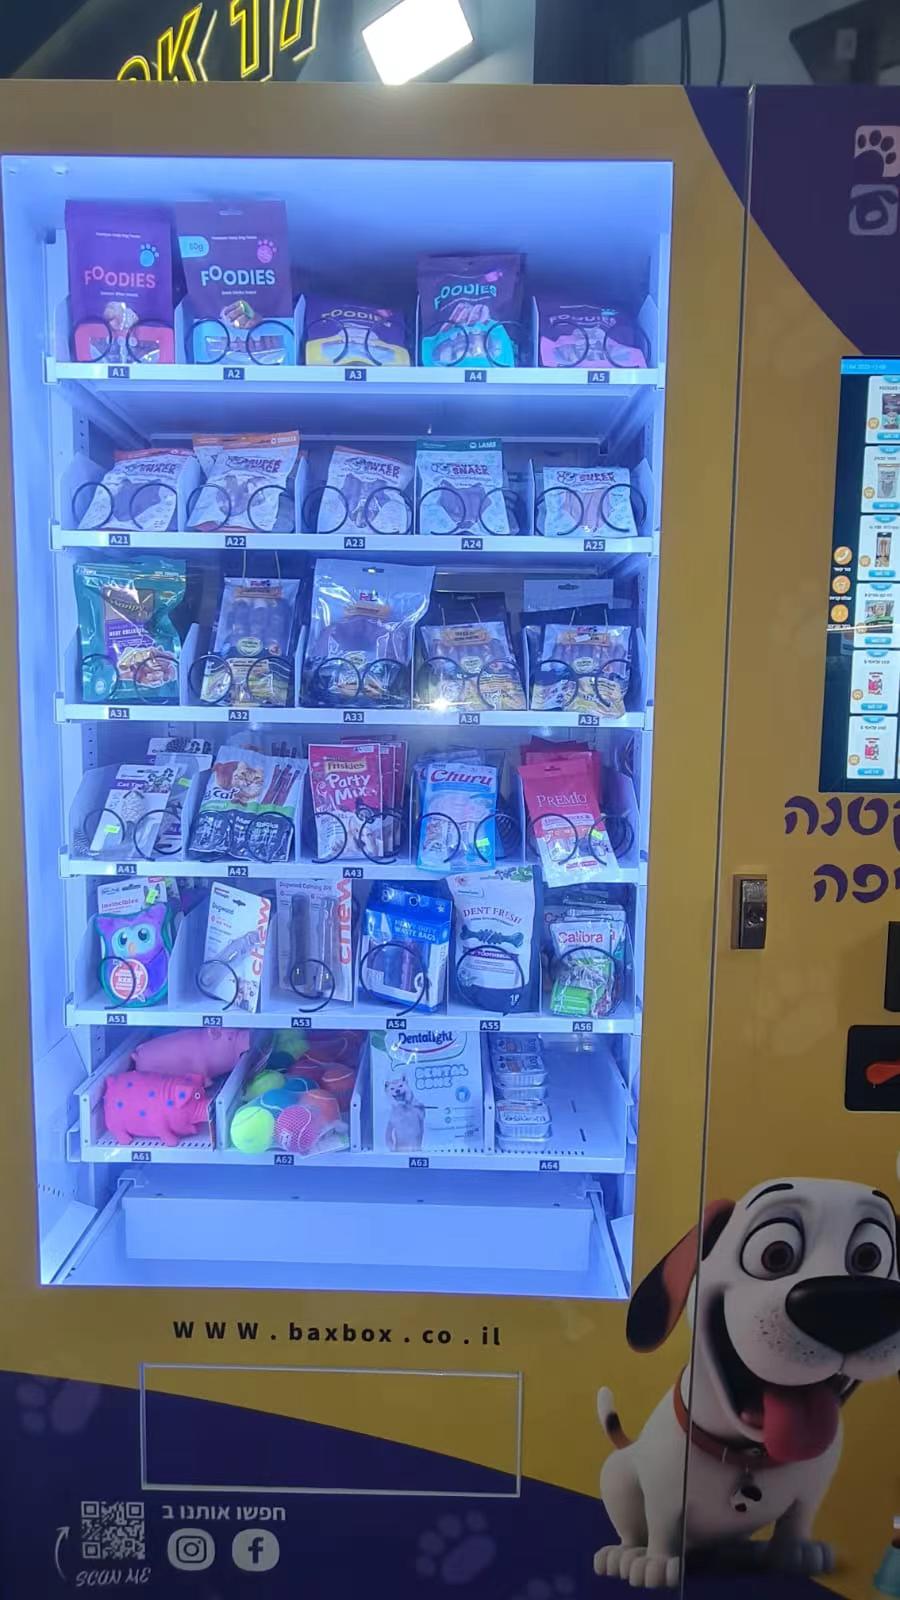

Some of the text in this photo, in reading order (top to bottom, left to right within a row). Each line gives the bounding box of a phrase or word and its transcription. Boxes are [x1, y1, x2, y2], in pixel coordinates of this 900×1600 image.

[84, 265, 157, 289] FOODIES
[201, 264, 276, 287] FOODIES
[434, 282, 497, 311] FOODIES
[109, 535, 129, 545] A21
[226, 537, 245, 547] A22
[345, 538, 364, 548] A23
[462, 540, 482, 549] A24
[585, 541, 604, 550] A25
[109, 708, 129, 719] A31
[229, 710, 249, 720] A32
[344, 712, 363, 722] A33
[460, 714, 479, 724] A34
[579, 716, 599, 725] A35
[326, 761, 366, 771] Friskies
[325, 773, 371, 789] Party
[429, 768, 493, 787] Churu
[335, 785, 368, 805] Mix
[535, 791, 588, 808] PREMIO
[785, 796, 900, 852] טנה
[117, 865, 136, 875] A41
[228, 867, 248, 876] A42
[343, 869, 363, 878] A43
[463, 906, 492, 918] DENT
[492, 907, 523, 925] FRESH
[417, 931, 437, 941] BAGS
[557, 931, 604, 944] Calibra
[107, 1014, 127, 1023] A51
[203, 1016, 222, 1026] A52
[292, 1018, 311, 1027] A53
[387, 1019, 406, 1029] A54
[480, 1021, 500, 1031] A55
[573, 1022, 592, 1032] A56
[398, 1031, 454, 1045] Dentalight
[132, 1152, 151, 1162] A61
[275, 1155, 294, 1165] A62
[410, 1158, 429, 1168] A63
[540, 1160, 559, 1171] A64
[162, 1504, 286, 1521] חפשו אותנו ב
[76, 1567, 151, 1587] SCAN ME
